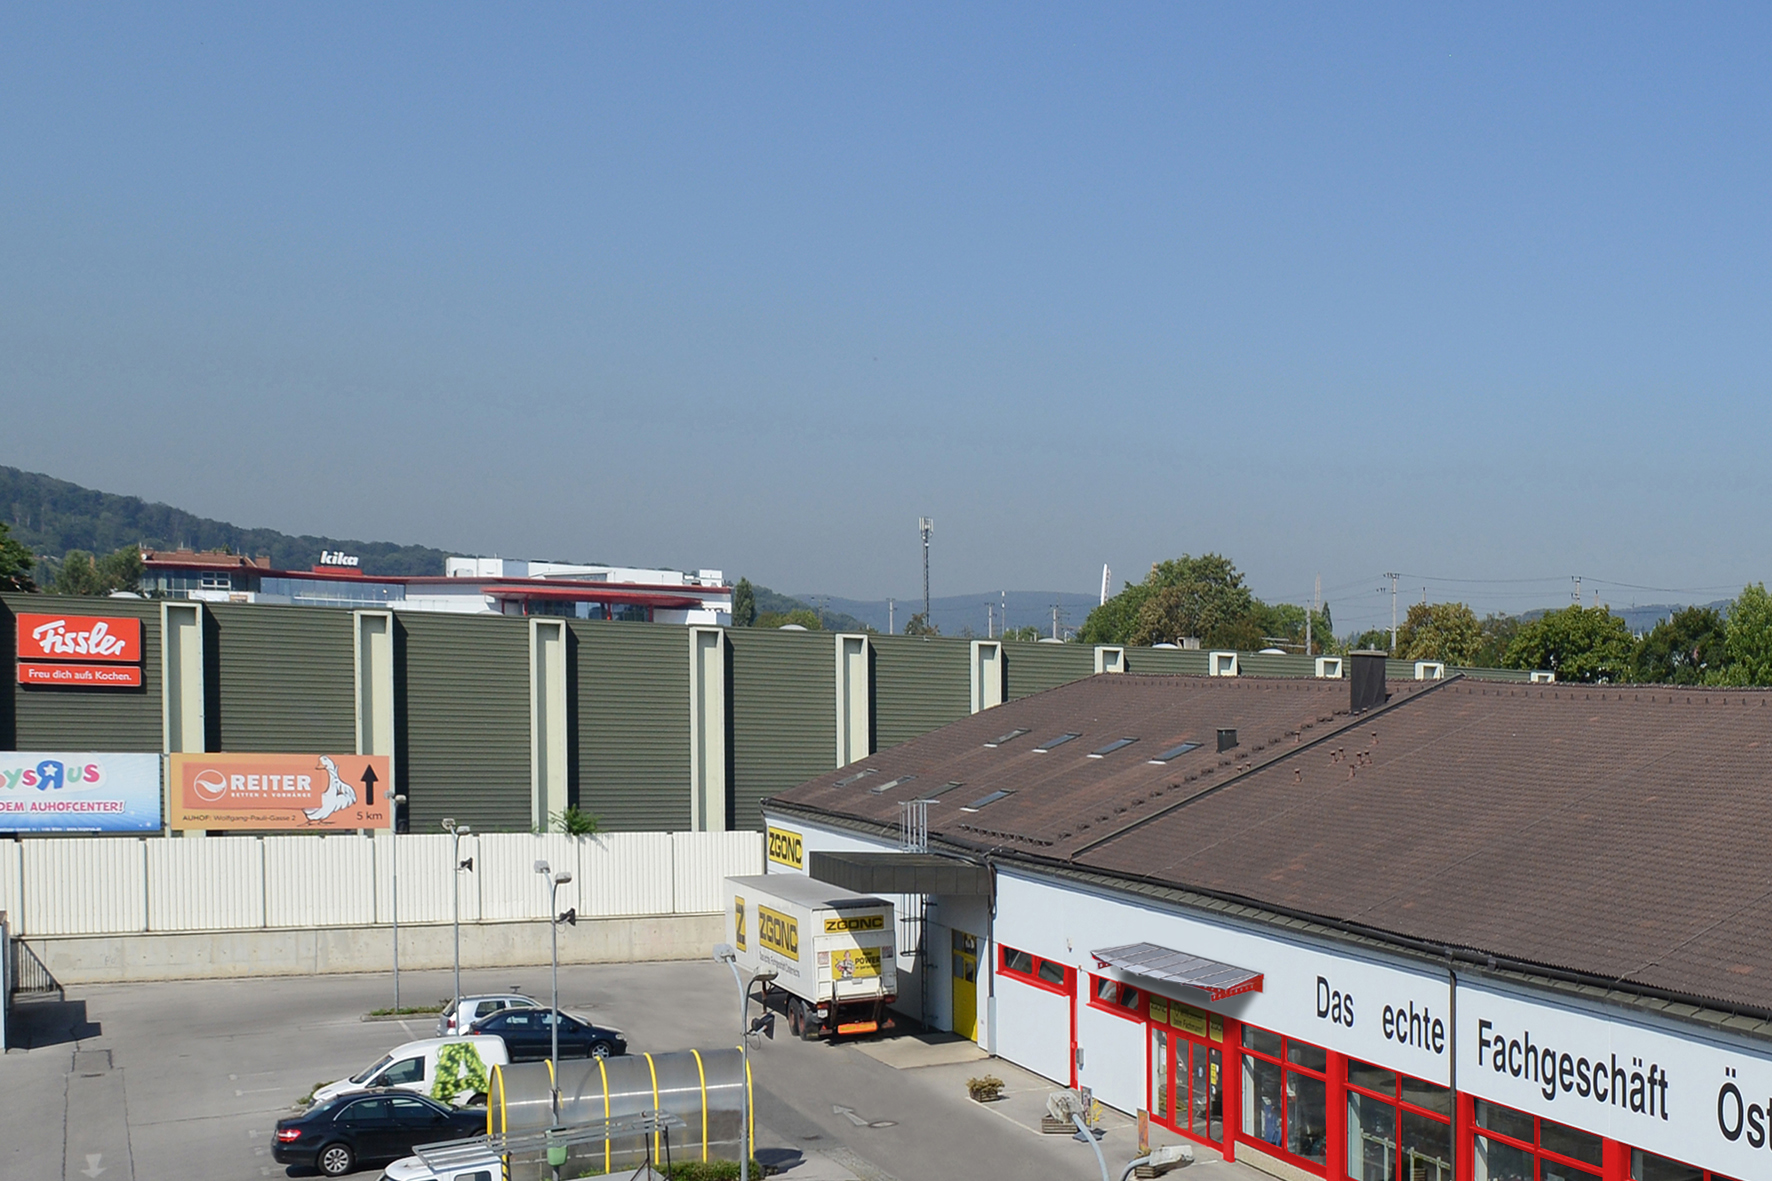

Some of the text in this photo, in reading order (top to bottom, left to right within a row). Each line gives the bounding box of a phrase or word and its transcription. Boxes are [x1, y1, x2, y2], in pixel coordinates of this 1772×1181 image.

[320, 550, 359, 566] kika
[32, 619, 126, 656] Fissler
[28, 668, 132, 682] Freu dich aufs Kochen.
[230, 774, 311, 791] REITER
[30, 801, 125, 812] AUHOFCENTER!
[356, 811, 383, 821] 5 km
[769, 831, 802, 864] ZGONC
[735, 902, 746, 945] Z
[826, 917, 883, 931] ZGONC
[759, 911, 798, 954] ZGONC
[1316, 975, 1355, 1029] Das
[1381, 1000, 1445, 1055] echte
[1477, 1018, 1669, 1120] Fachgeschäft
